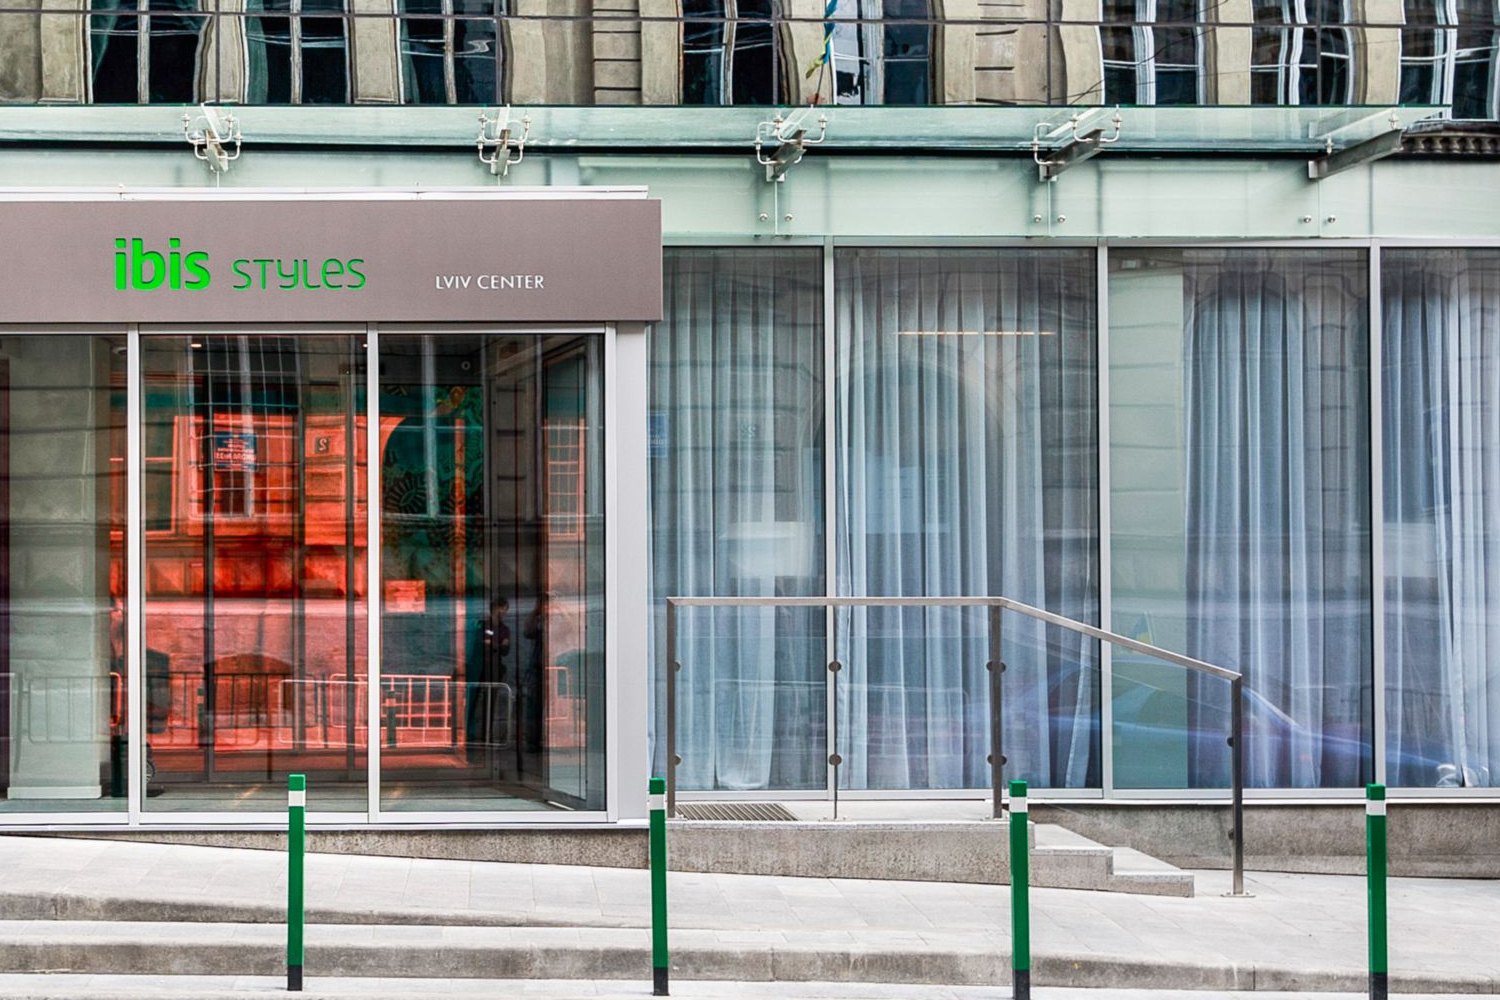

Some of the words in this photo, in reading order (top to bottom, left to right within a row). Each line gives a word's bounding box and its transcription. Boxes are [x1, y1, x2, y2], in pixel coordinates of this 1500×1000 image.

[114, 237, 212, 291] ibis
[435, 275, 472, 290] LVIV
[476, 274, 545, 290] CENTER
